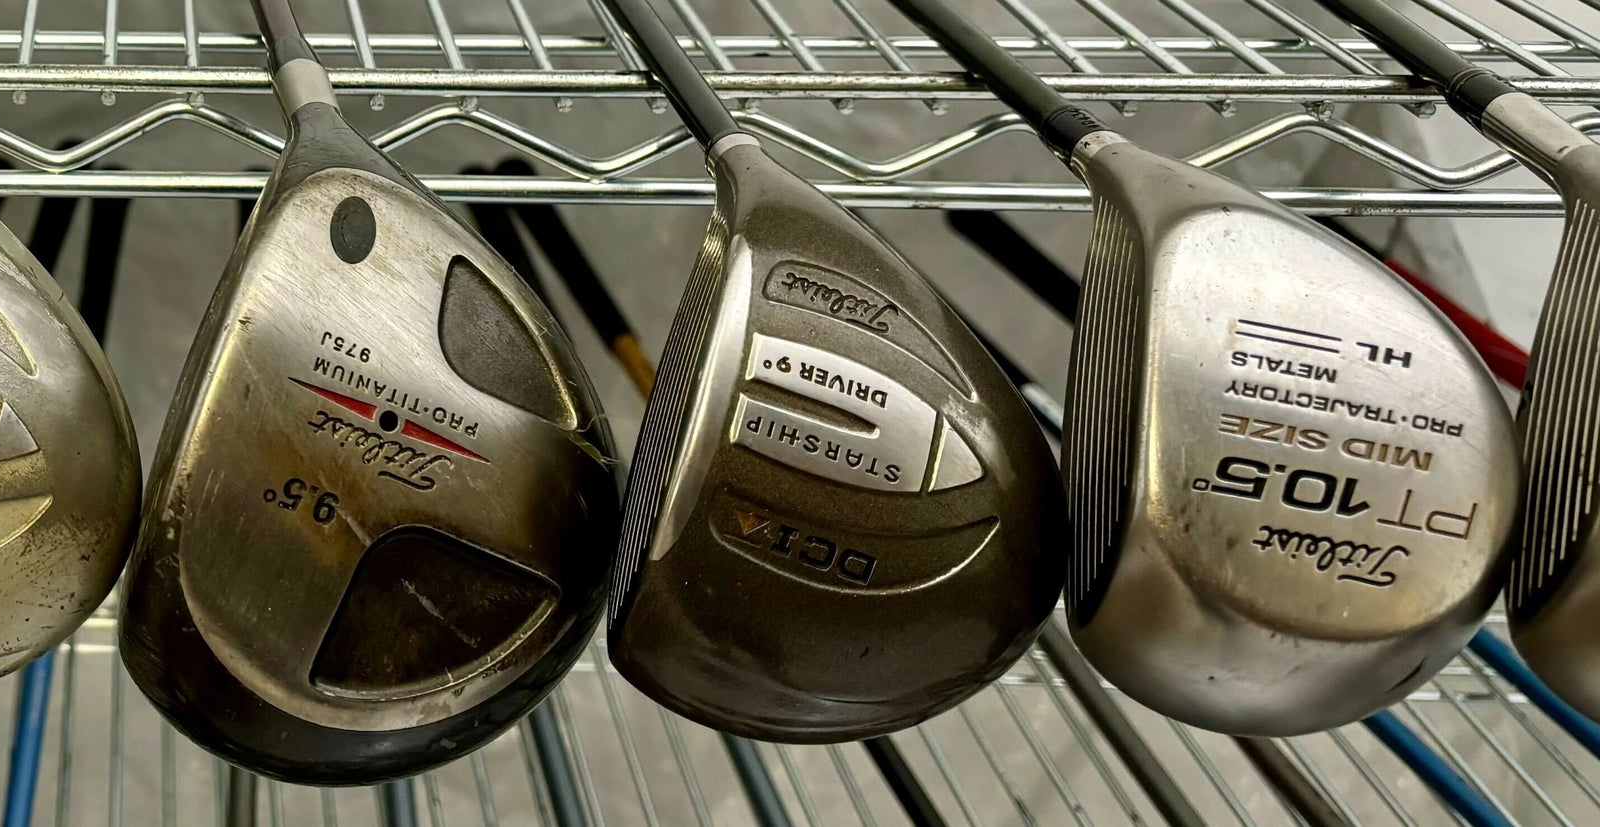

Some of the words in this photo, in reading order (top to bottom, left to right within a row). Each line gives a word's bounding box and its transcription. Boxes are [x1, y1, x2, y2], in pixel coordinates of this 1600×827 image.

[781, 272, 899, 335] Titleist
[320, 331, 371, 363] 975J
[1231, 350, 1337, 384] METALS
[1356, 341, 1412, 369] HL
[799, 361, 888, 409] DRIVER
[308, 411, 455, 491] Titleist
[746, 415, 902, 483] STARSHIP
[1218, 413, 1330, 451] SIZE
[1340, 437, 1434, 472] MID
[1192, 456, 1370, 519] 10.5°
[1376, 489, 1478, 540] PT
[771, 525, 877, 585] DCI
[1252, 525, 1411, 588] Titleist
